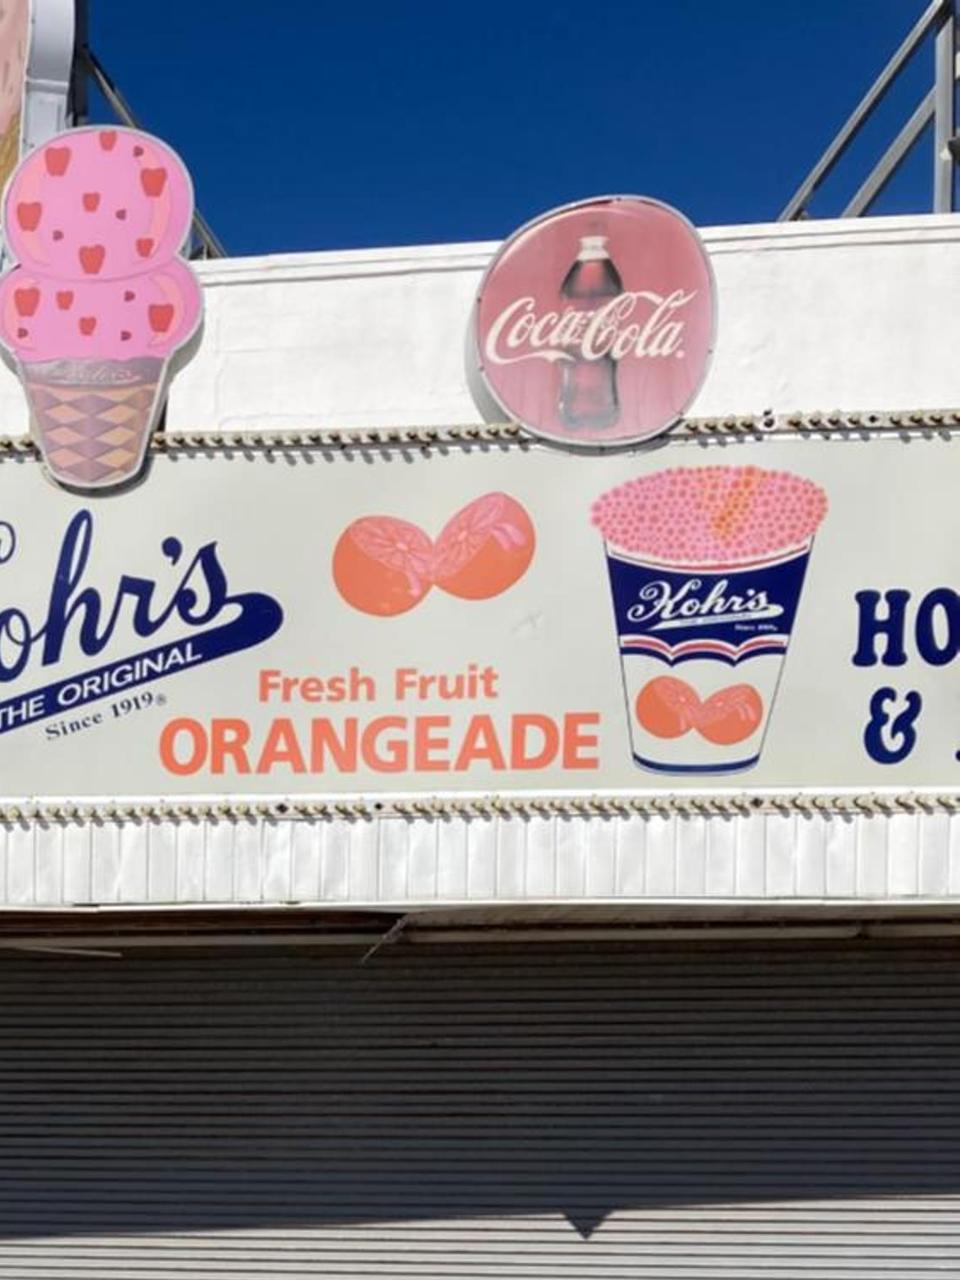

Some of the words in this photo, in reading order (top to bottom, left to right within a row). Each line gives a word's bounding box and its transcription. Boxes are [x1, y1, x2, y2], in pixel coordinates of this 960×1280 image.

[57, 642, 203, 707] ORIGINAL
[259, 668, 376, 702] Fresh
[395, 663, 499, 701] Fruit
[44, 712, 104, 741] Since
[159, 712, 600, 776] ORANGEADE
[864, 687, 922, 765] &
